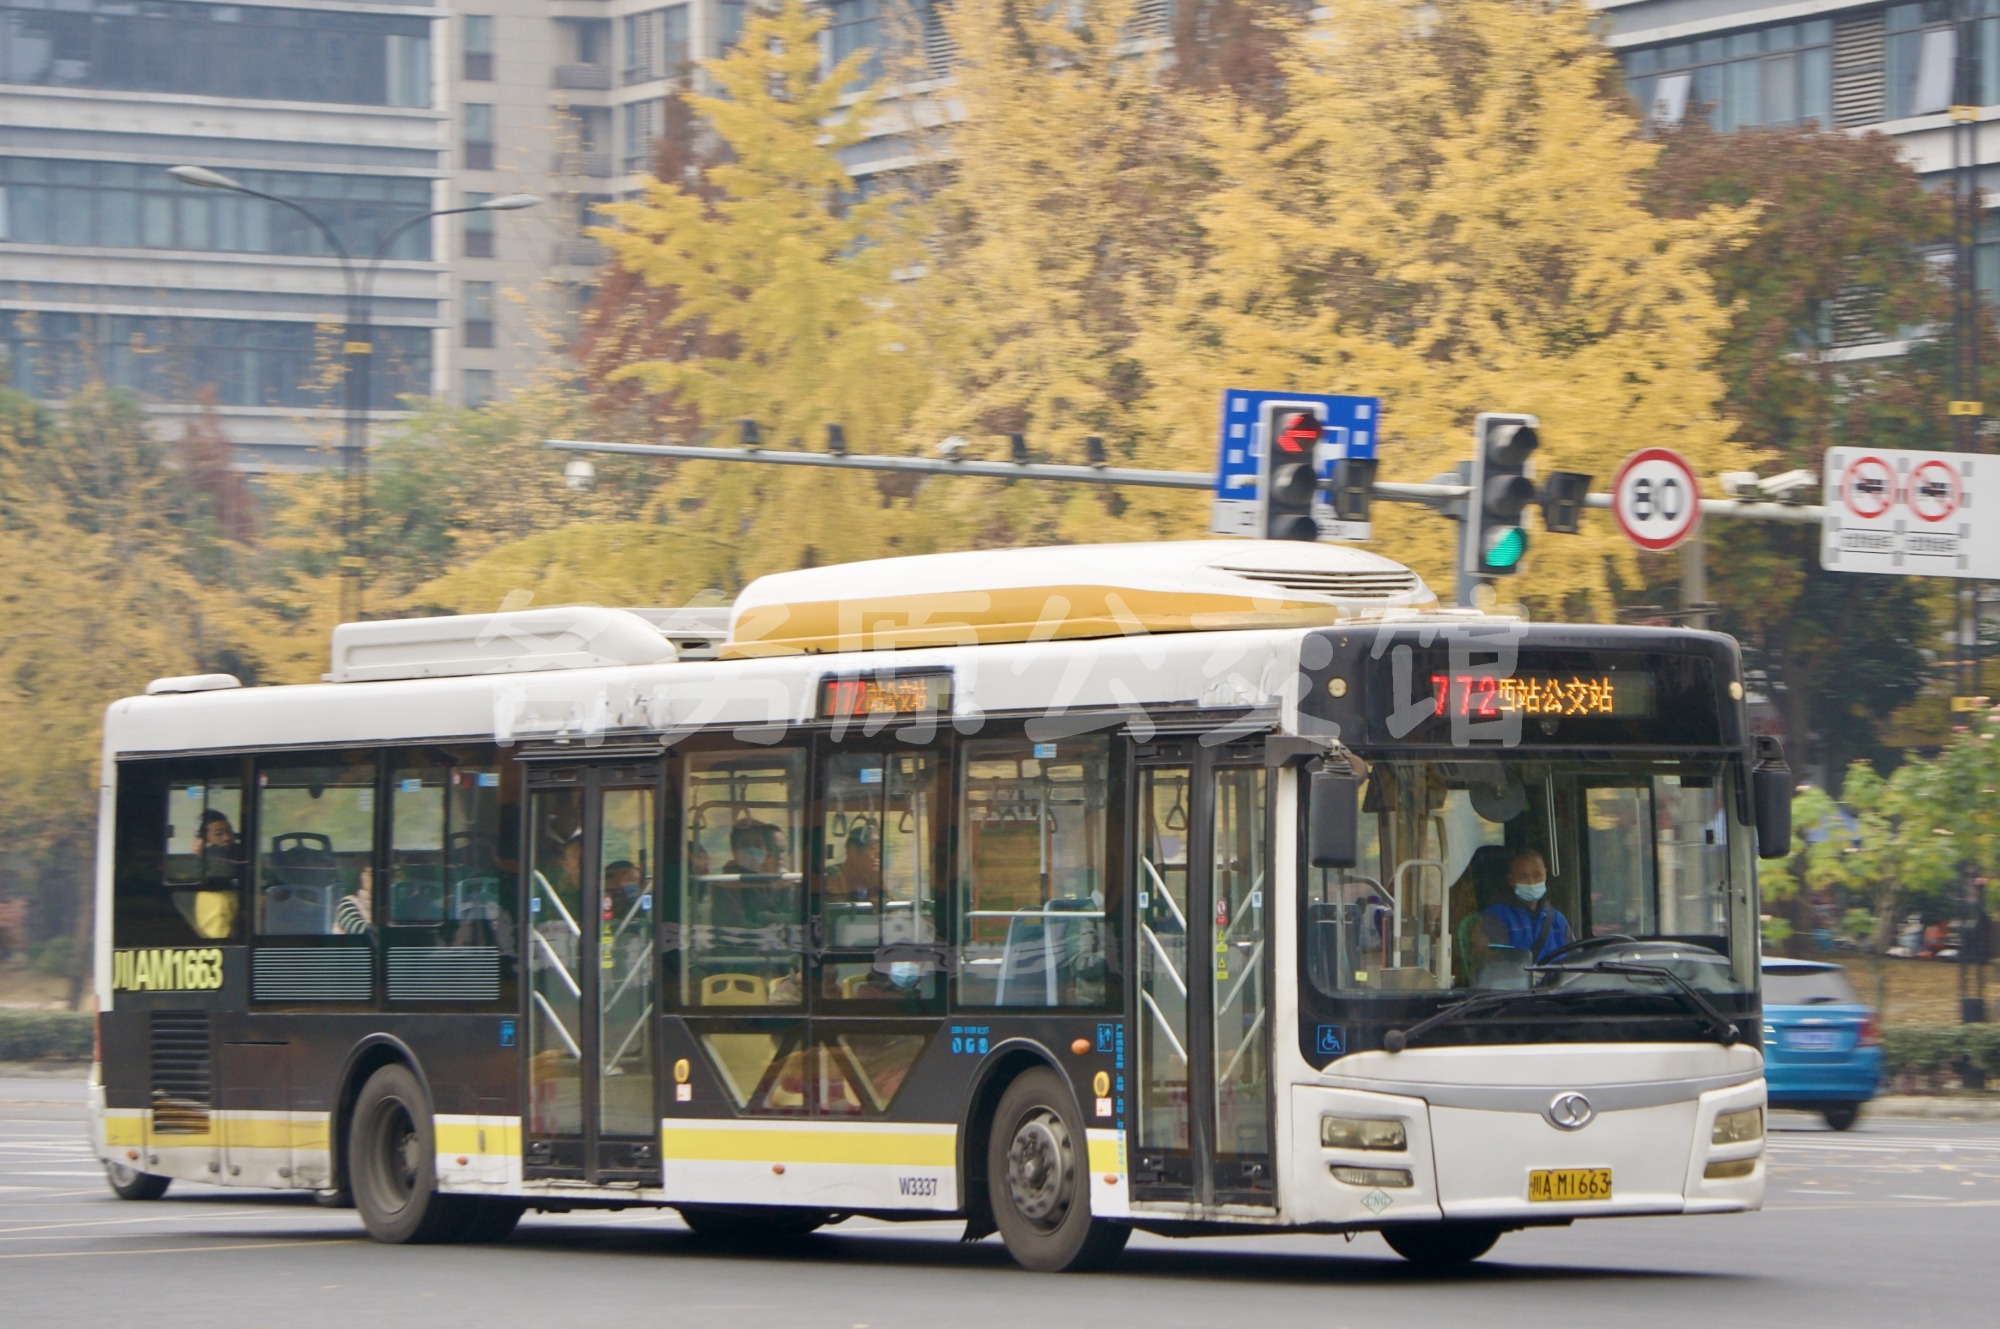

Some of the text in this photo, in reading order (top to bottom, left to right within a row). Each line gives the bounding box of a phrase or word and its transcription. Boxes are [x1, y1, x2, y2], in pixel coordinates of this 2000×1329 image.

[1630, 478, 1684, 521] 80
[826, 680, 866, 715] 772
[1430, 675, 1497, 716] 772
[899, 1177, 938, 1196] W3337
[1365, 1195, 1388, 1207] CNG
